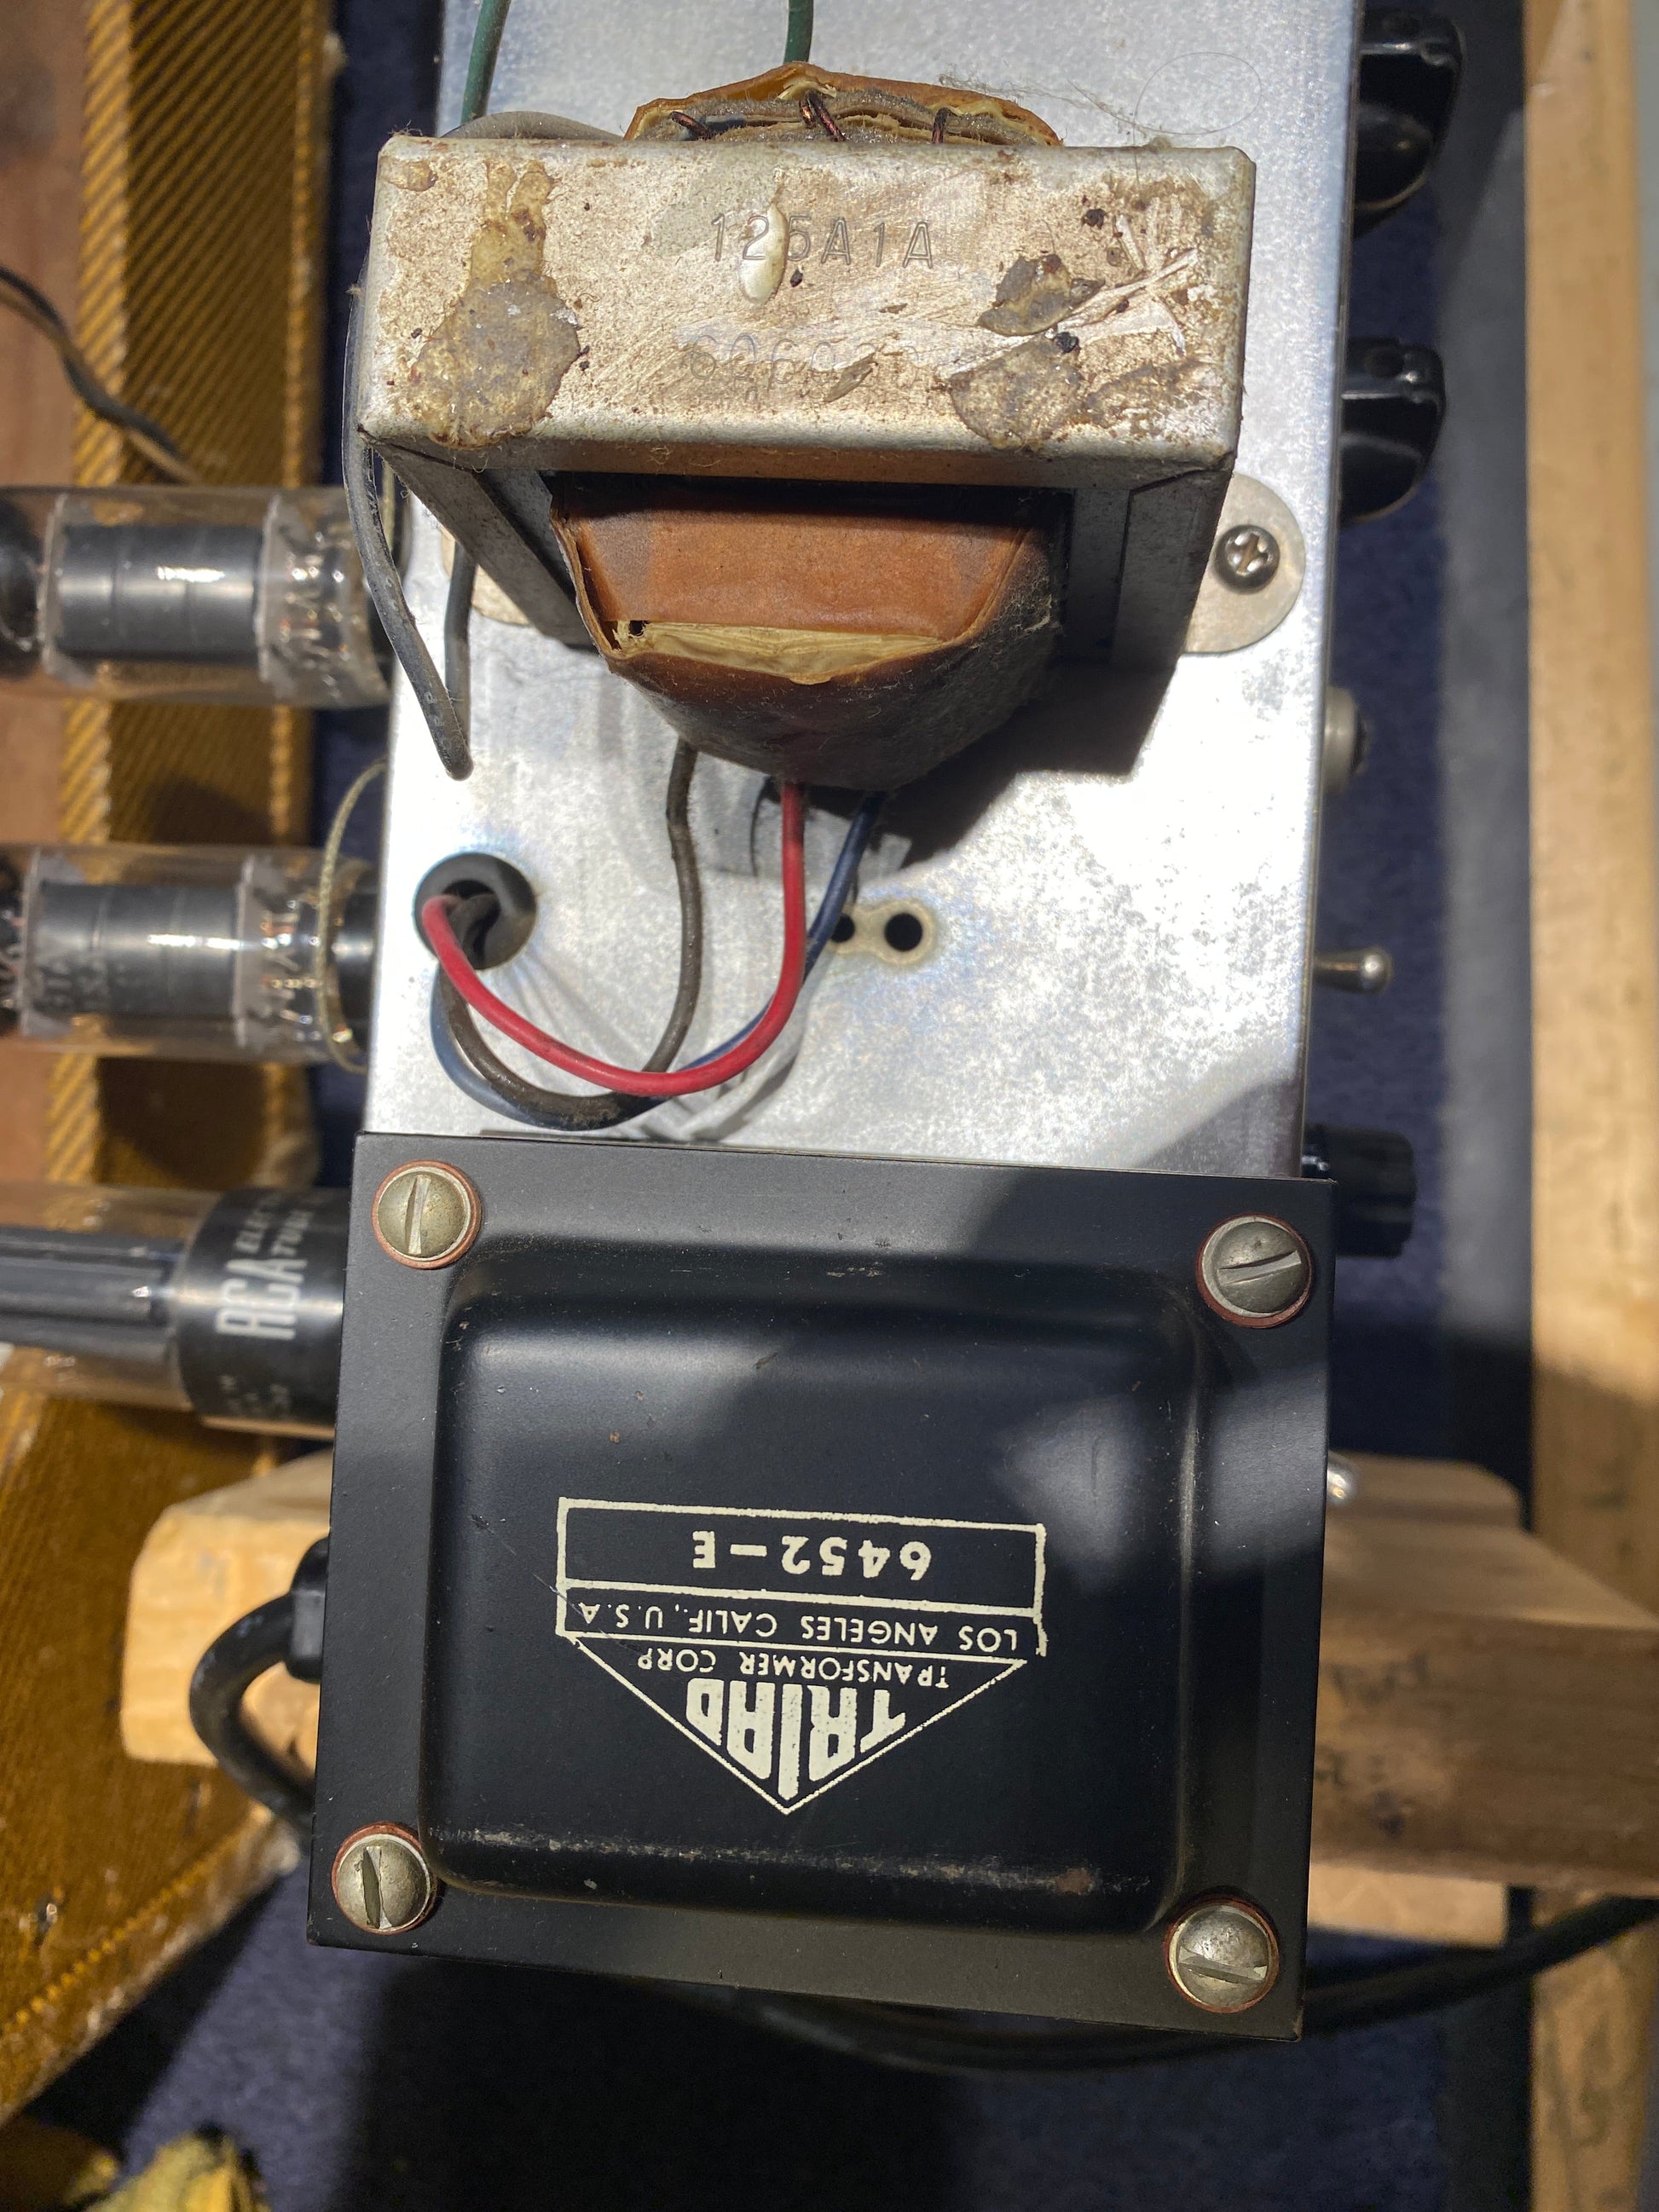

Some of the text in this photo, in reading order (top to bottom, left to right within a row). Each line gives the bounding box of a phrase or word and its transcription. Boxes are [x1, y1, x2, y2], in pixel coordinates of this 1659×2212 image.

[711, 212, 934, 269] 125A1A
[216, 1258, 309, 1340] RCA
[800, 1615, 939, 1646] ANGELES
[958, 1625, 1017, 1653] LOS
[637, 1647, 950, 1689] TRANSFORMER CORP
[685, 1678, 906, 1801] TRIAD
